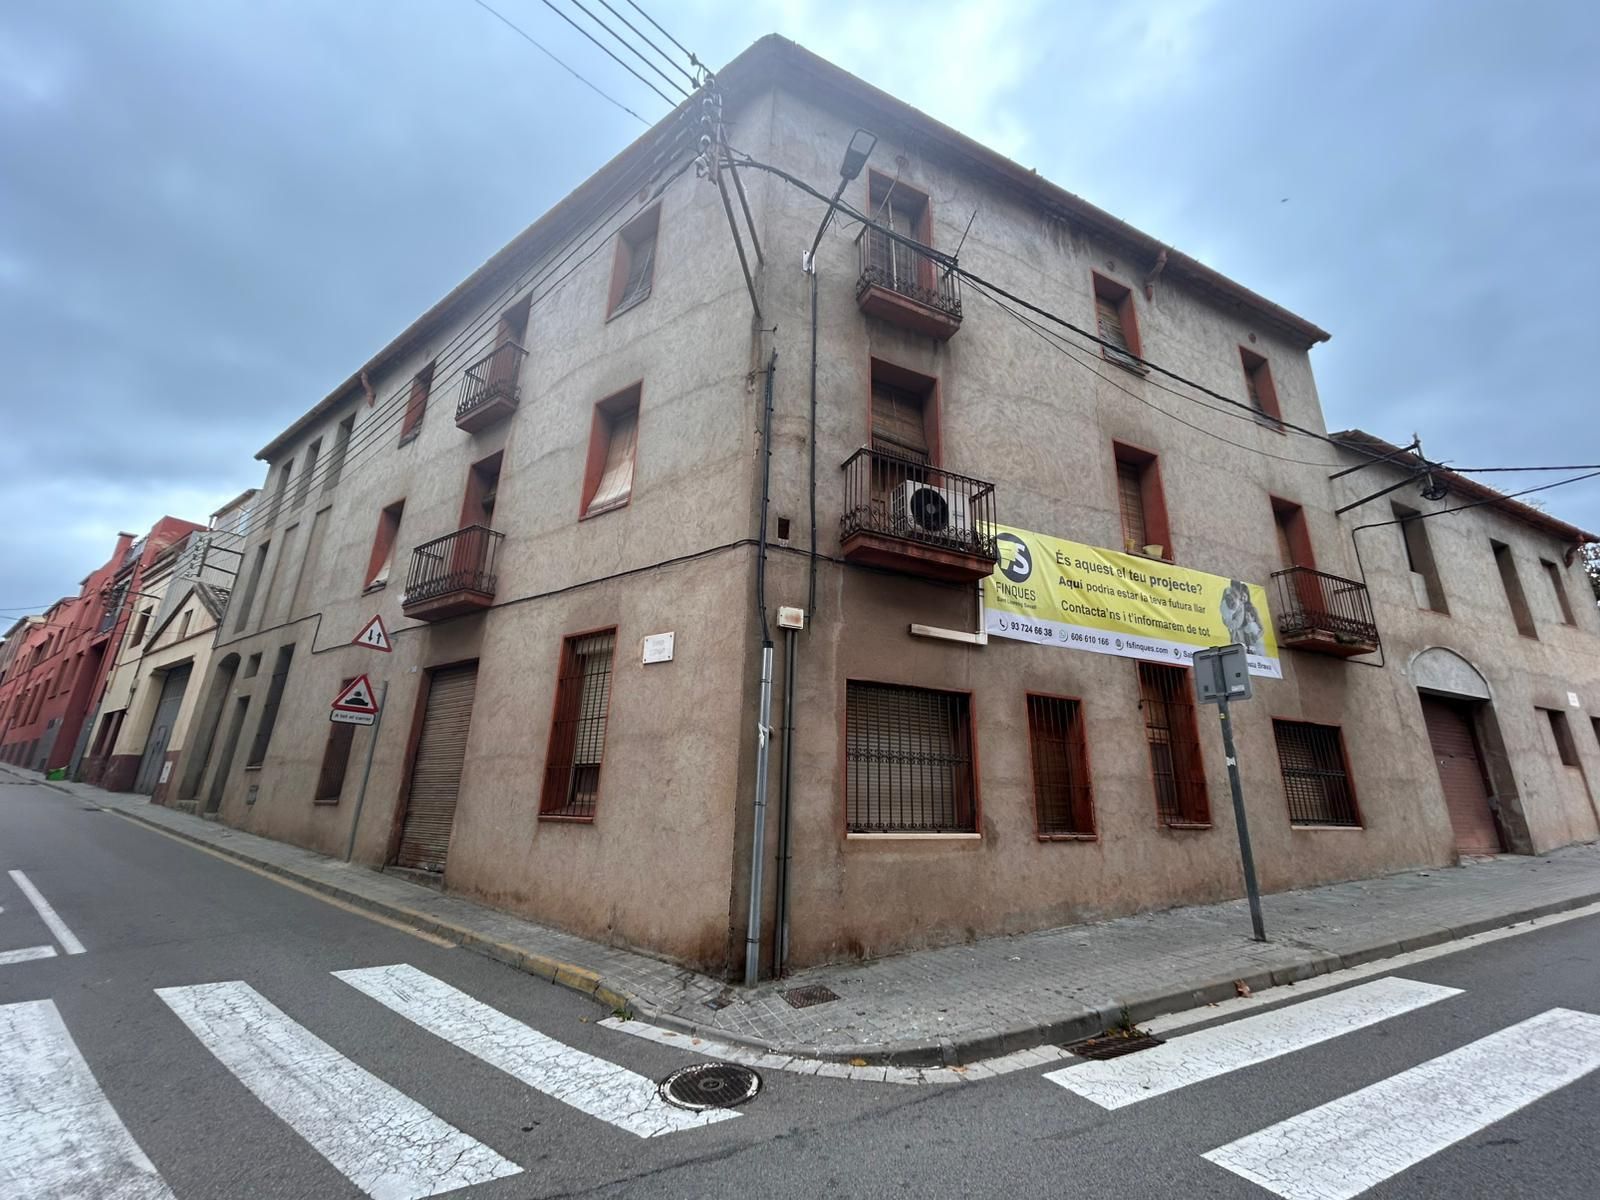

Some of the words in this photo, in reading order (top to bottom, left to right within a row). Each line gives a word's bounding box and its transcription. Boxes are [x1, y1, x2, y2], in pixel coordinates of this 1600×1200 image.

[1056, 550, 1071, 567] És
[1075, 557, 1115, 577] aquest
[1117, 567, 1125, 578] el
[1129, 569, 1146, 583] teu
[1150, 576, 1203, 595] projecte?
[996, 581, 1036, 602] FINQUES
[1086, 583, 1115, 596] podria
[1117, 590, 1138, 601] estar
[1140, 592, 1149, 603] la
[1149, 595, 1168, 607] teva
[1169, 598, 1193, 611] futura
[1194, 602, 1206, 614] llar
[1010, 621, 1020, 631] 93
[1021, 623, 1033, 633] 724
[1034, 626, 1043, 635] 66
[1043, 628, 1053, 637] 38
[1061, 600, 1121, 621] Contacta'ns
[1123, 609, 1127, 622] i
[1128, 612, 1185, 632] t'informarem
[1186, 623, 1198, 635] de
[1198, 627, 1211, 637] tot
[1070, 632, 1083, 642] 606
[1084, 634, 1096, 644] 610
[1126, 641, 1168, 654] fsfinques.com
